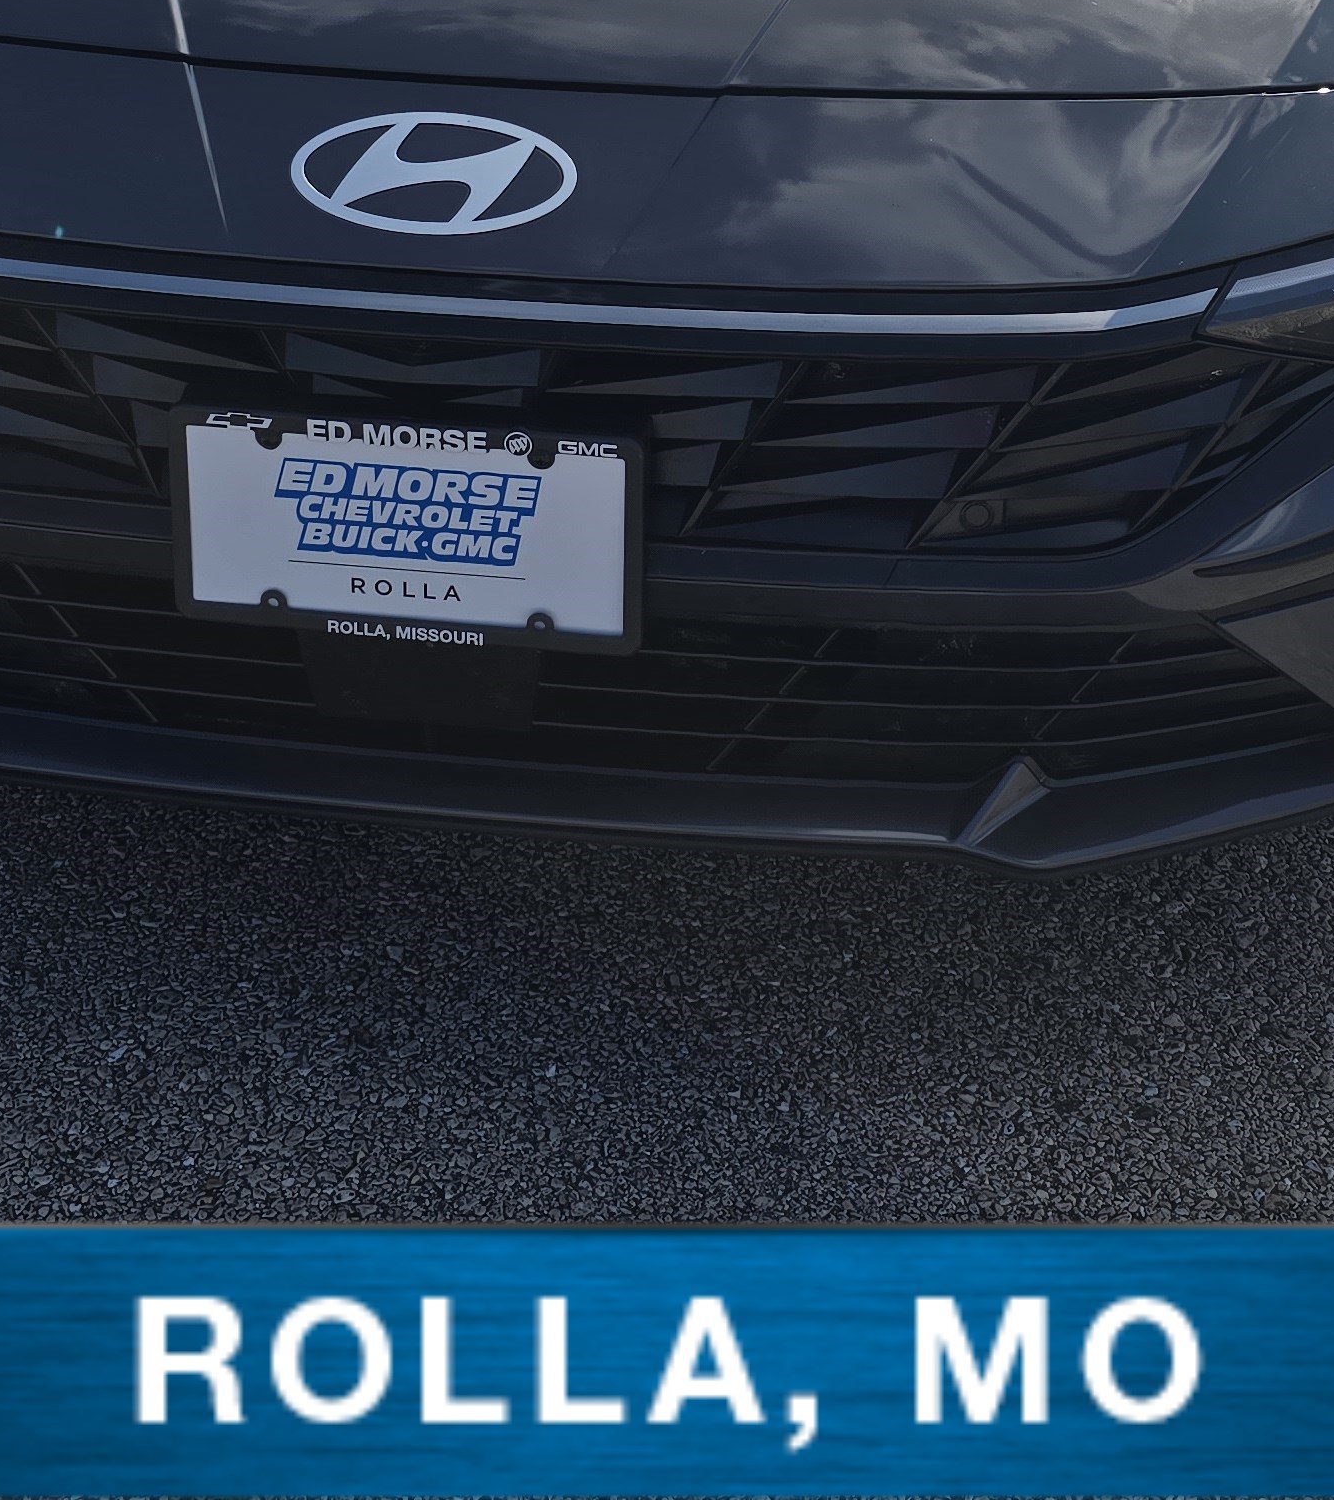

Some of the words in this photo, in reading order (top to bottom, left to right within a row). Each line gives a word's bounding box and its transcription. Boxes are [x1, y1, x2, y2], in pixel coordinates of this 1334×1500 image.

[306, 418, 352, 444] ED
[361, 423, 488, 455] MORSE
[557, 440, 618, 458] GMC
[278, 460, 347, 494] ED
[351, 466, 539, 509] MORSE
[299, 494, 519, 533] CHEVROLET
[350, 577, 462, 601] ROLLA
[326, 619, 391, 641] ROLLA,
[394, 625, 485, 646] MISSOURI
